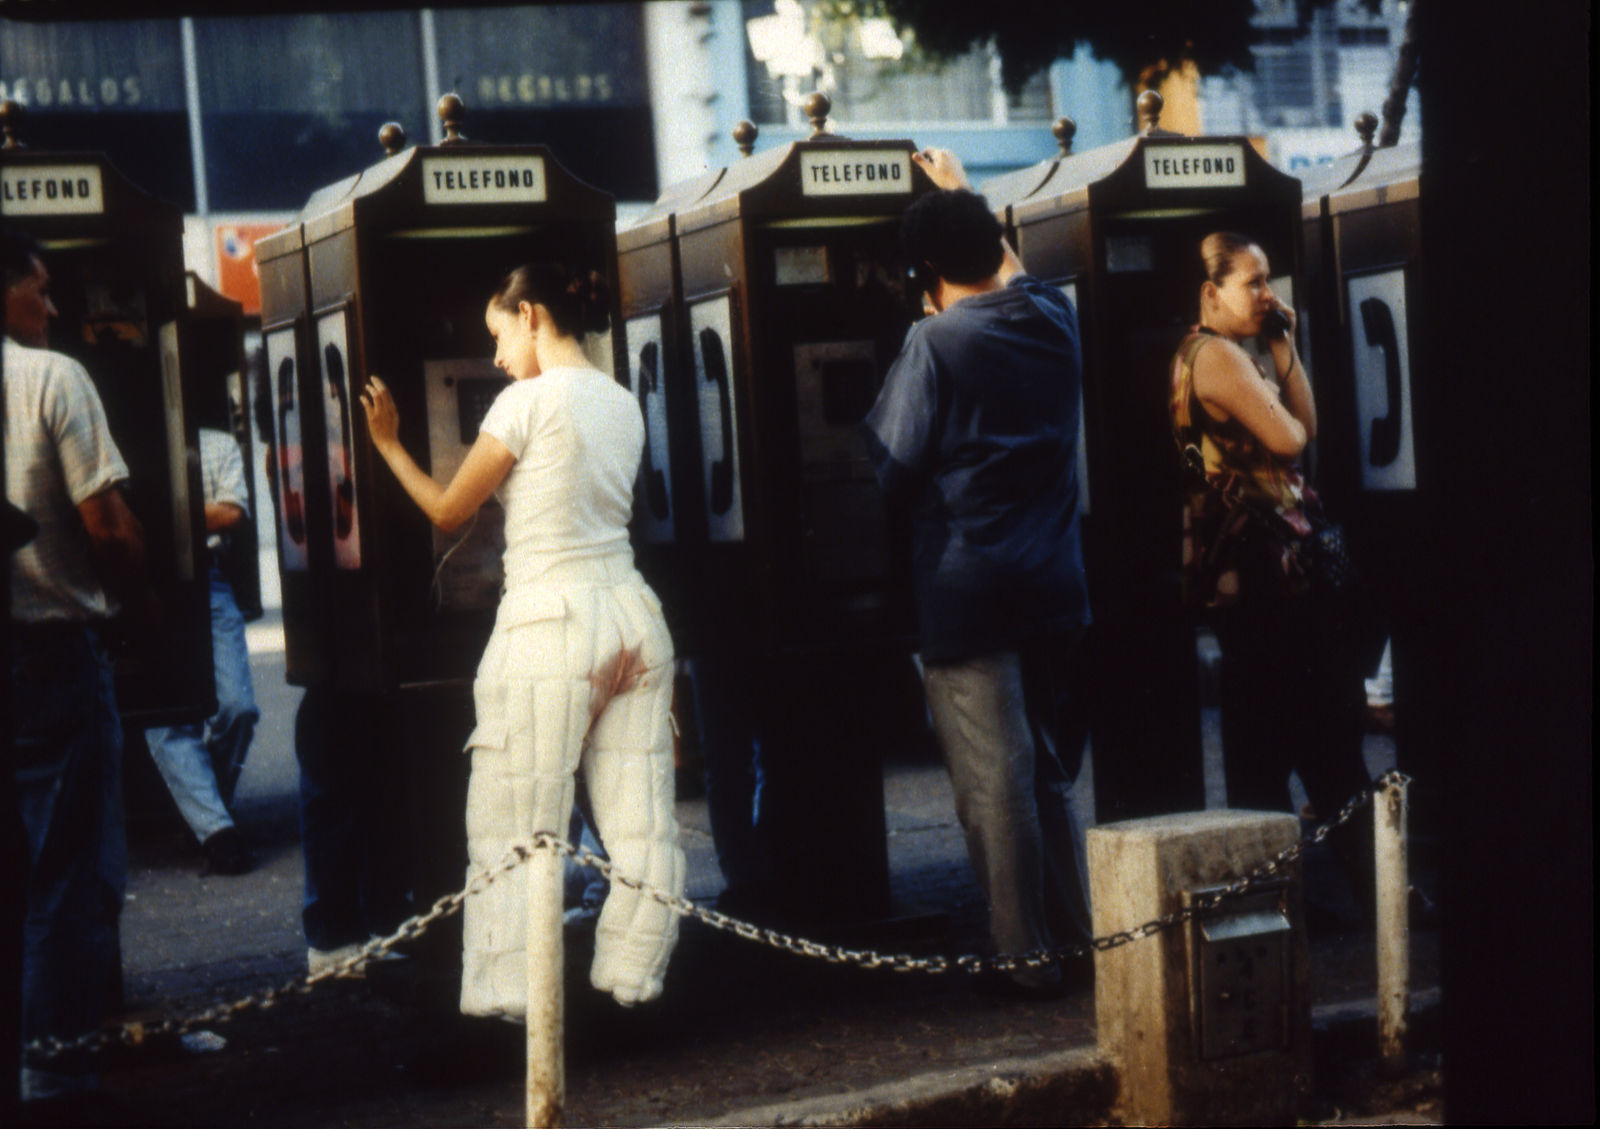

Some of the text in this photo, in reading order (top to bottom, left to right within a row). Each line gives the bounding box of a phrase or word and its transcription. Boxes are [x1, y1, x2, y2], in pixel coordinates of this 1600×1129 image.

[811, 162, 901, 182] TELEFONO
[1153, 157, 1235, 175] TELEFONO
[433, 169, 534, 190] TELEFONO
